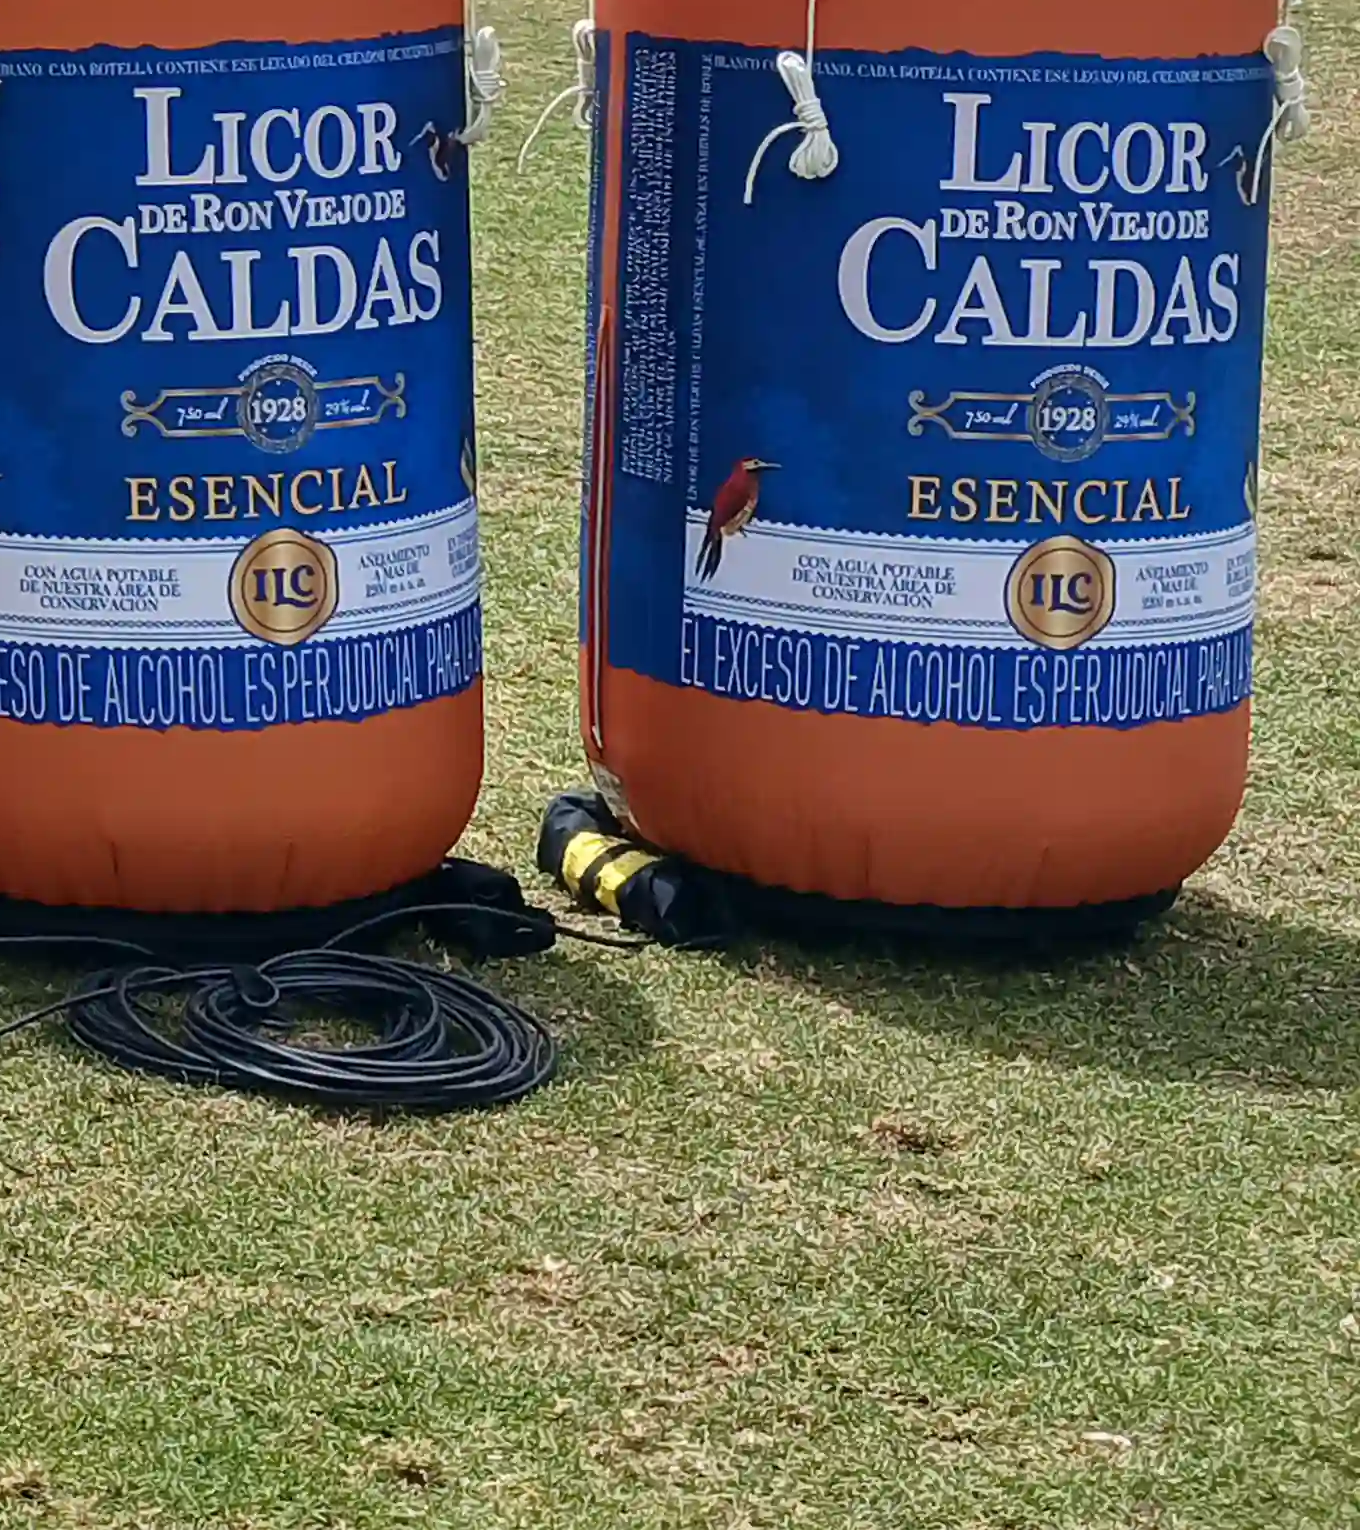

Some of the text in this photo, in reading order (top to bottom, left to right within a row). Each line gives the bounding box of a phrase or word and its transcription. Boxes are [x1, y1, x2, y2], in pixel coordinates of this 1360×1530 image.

[133, 86, 402, 187] LICOR
[939, 92, 1209, 195] LICOR
[139, 188, 406, 235] DE RON VIEJO DE
[940, 199, 1209, 242] DE RON VIEJO DE
[44, 215, 443, 344] CALDAS
[838, 216, 1240, 348] CALDAS
[251, 397, 307, 424] 1928
[1039, 405, 1097, 432] 1928
[124, 460, 407, 521] ESENCIAL
[907, 475, 1192, 525] ESENCIAL
[24, 565, 56, 580] CON
[60, 568, 101, 582] AGUA
[252, 564, 318, 609] ILC
[792, 568, 812, 583] DE
[934, 580, 957, 595] DE
[798, 554, 831, 571] CON
[836, 558, 878, 574] AGUA
[20, 579, 40, 594] DE
[159, 582, 180, 598] DE
[1028, 572, 1093, 615] ILC
[57, 651, 93, 723] DE
[103, 653, 234, 725] ALCOHOL
[681, 618, 706, 687] EL
[714, 624, 812, 707] EXCESO
[823, 641, 861, 713] DE
[869, 646, 1001, 722] ALCOHOL
